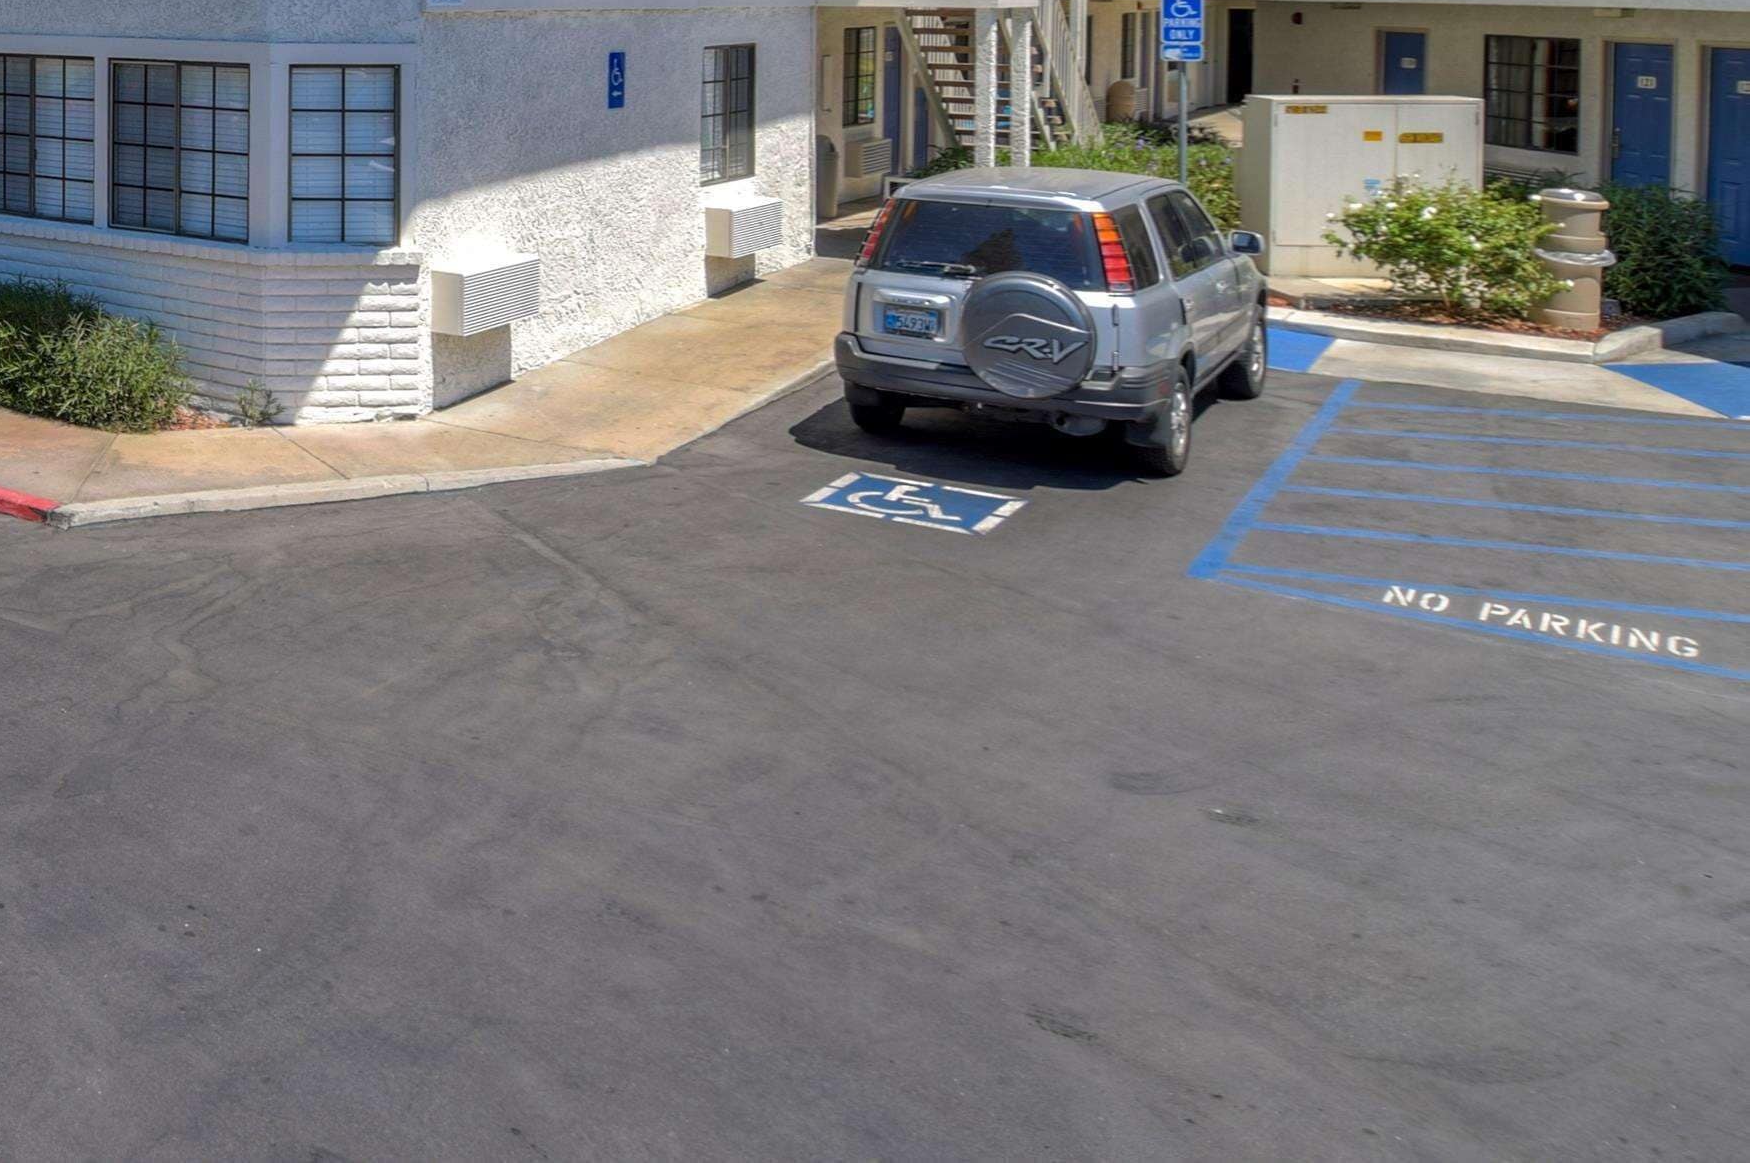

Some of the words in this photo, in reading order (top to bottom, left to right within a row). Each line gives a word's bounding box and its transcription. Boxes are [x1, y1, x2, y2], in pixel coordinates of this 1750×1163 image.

[1169, 29, 1195, 40] ONLY
[1382, 585, 1449, 613] NO
[1479, 602, 1699, 658] PARKING
